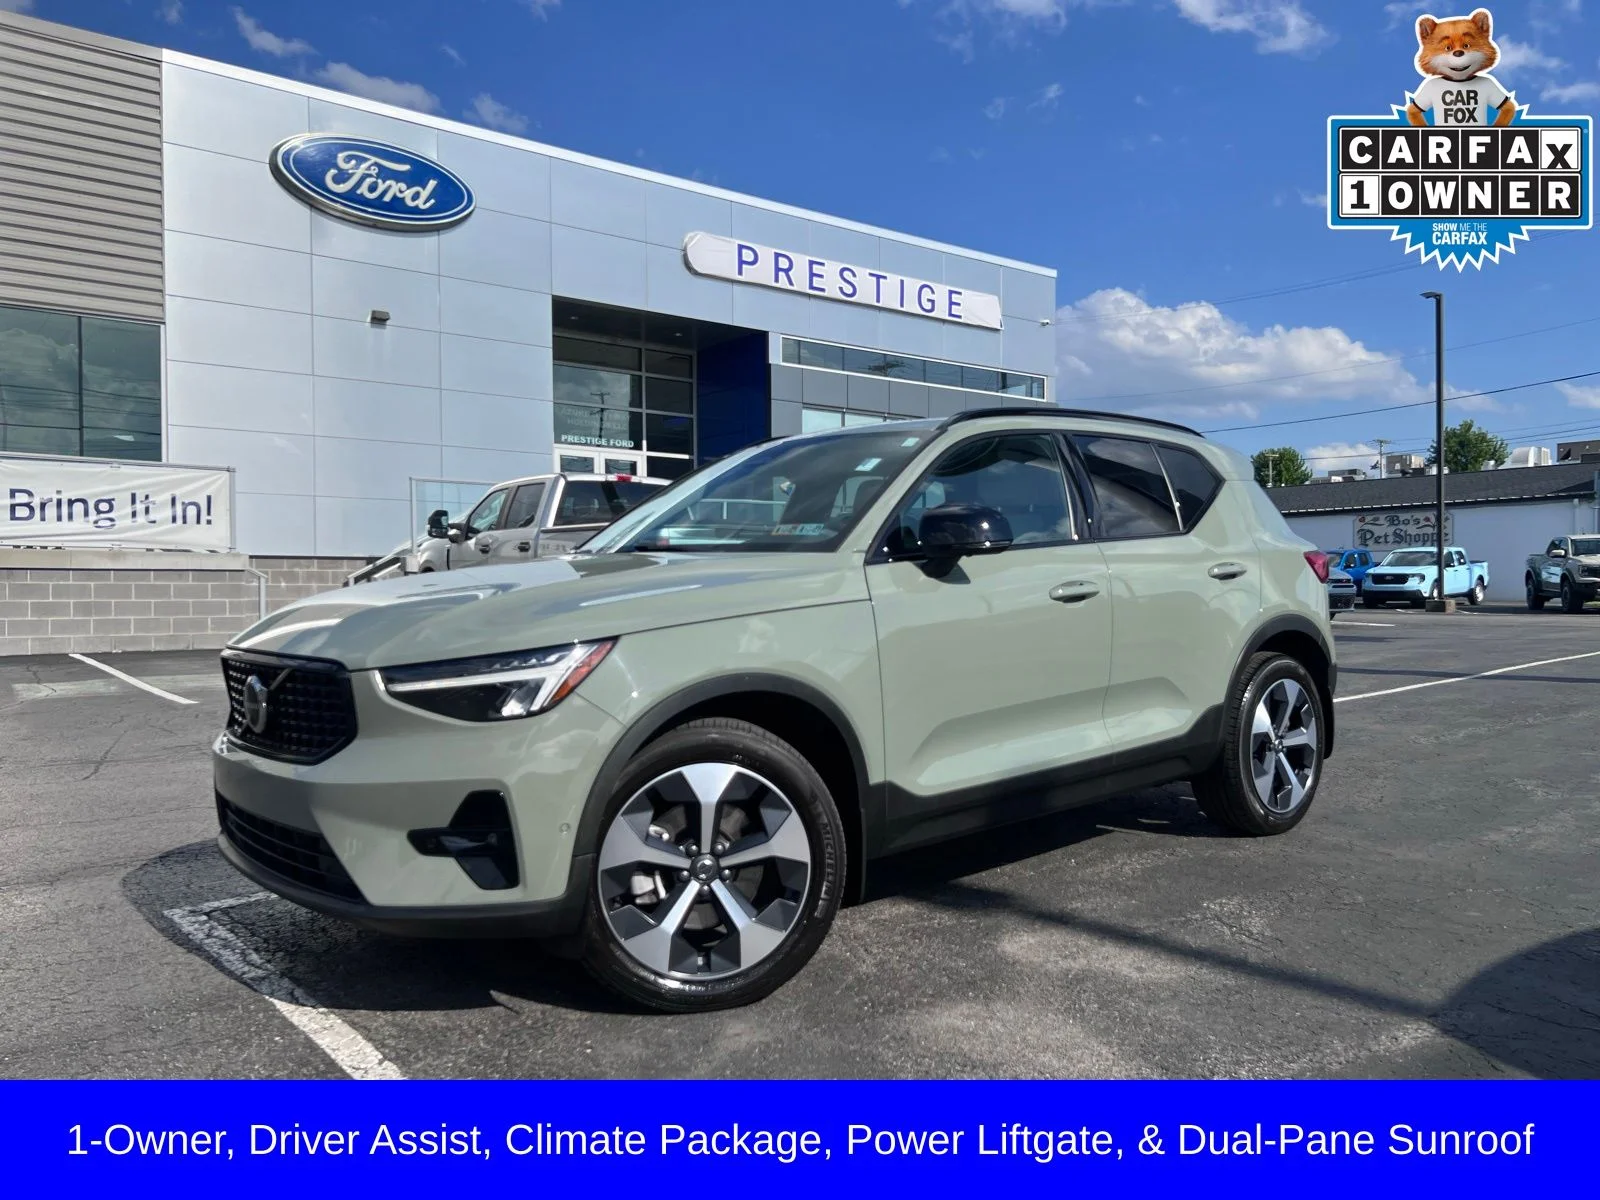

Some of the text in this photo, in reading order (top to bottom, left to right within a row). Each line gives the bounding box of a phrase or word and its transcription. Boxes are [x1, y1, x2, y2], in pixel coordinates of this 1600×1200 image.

[324, 150, 438, 210] Ford
[736, 243, 963, 319] PRESTIGE
[561, 434, 635, 448] PRESTIGE FORD
[9, 488, 213, 530] Bring It In!
[1384, 514, 1421, 527] Bo's
[1357, 528, 1391, 547] Pet
